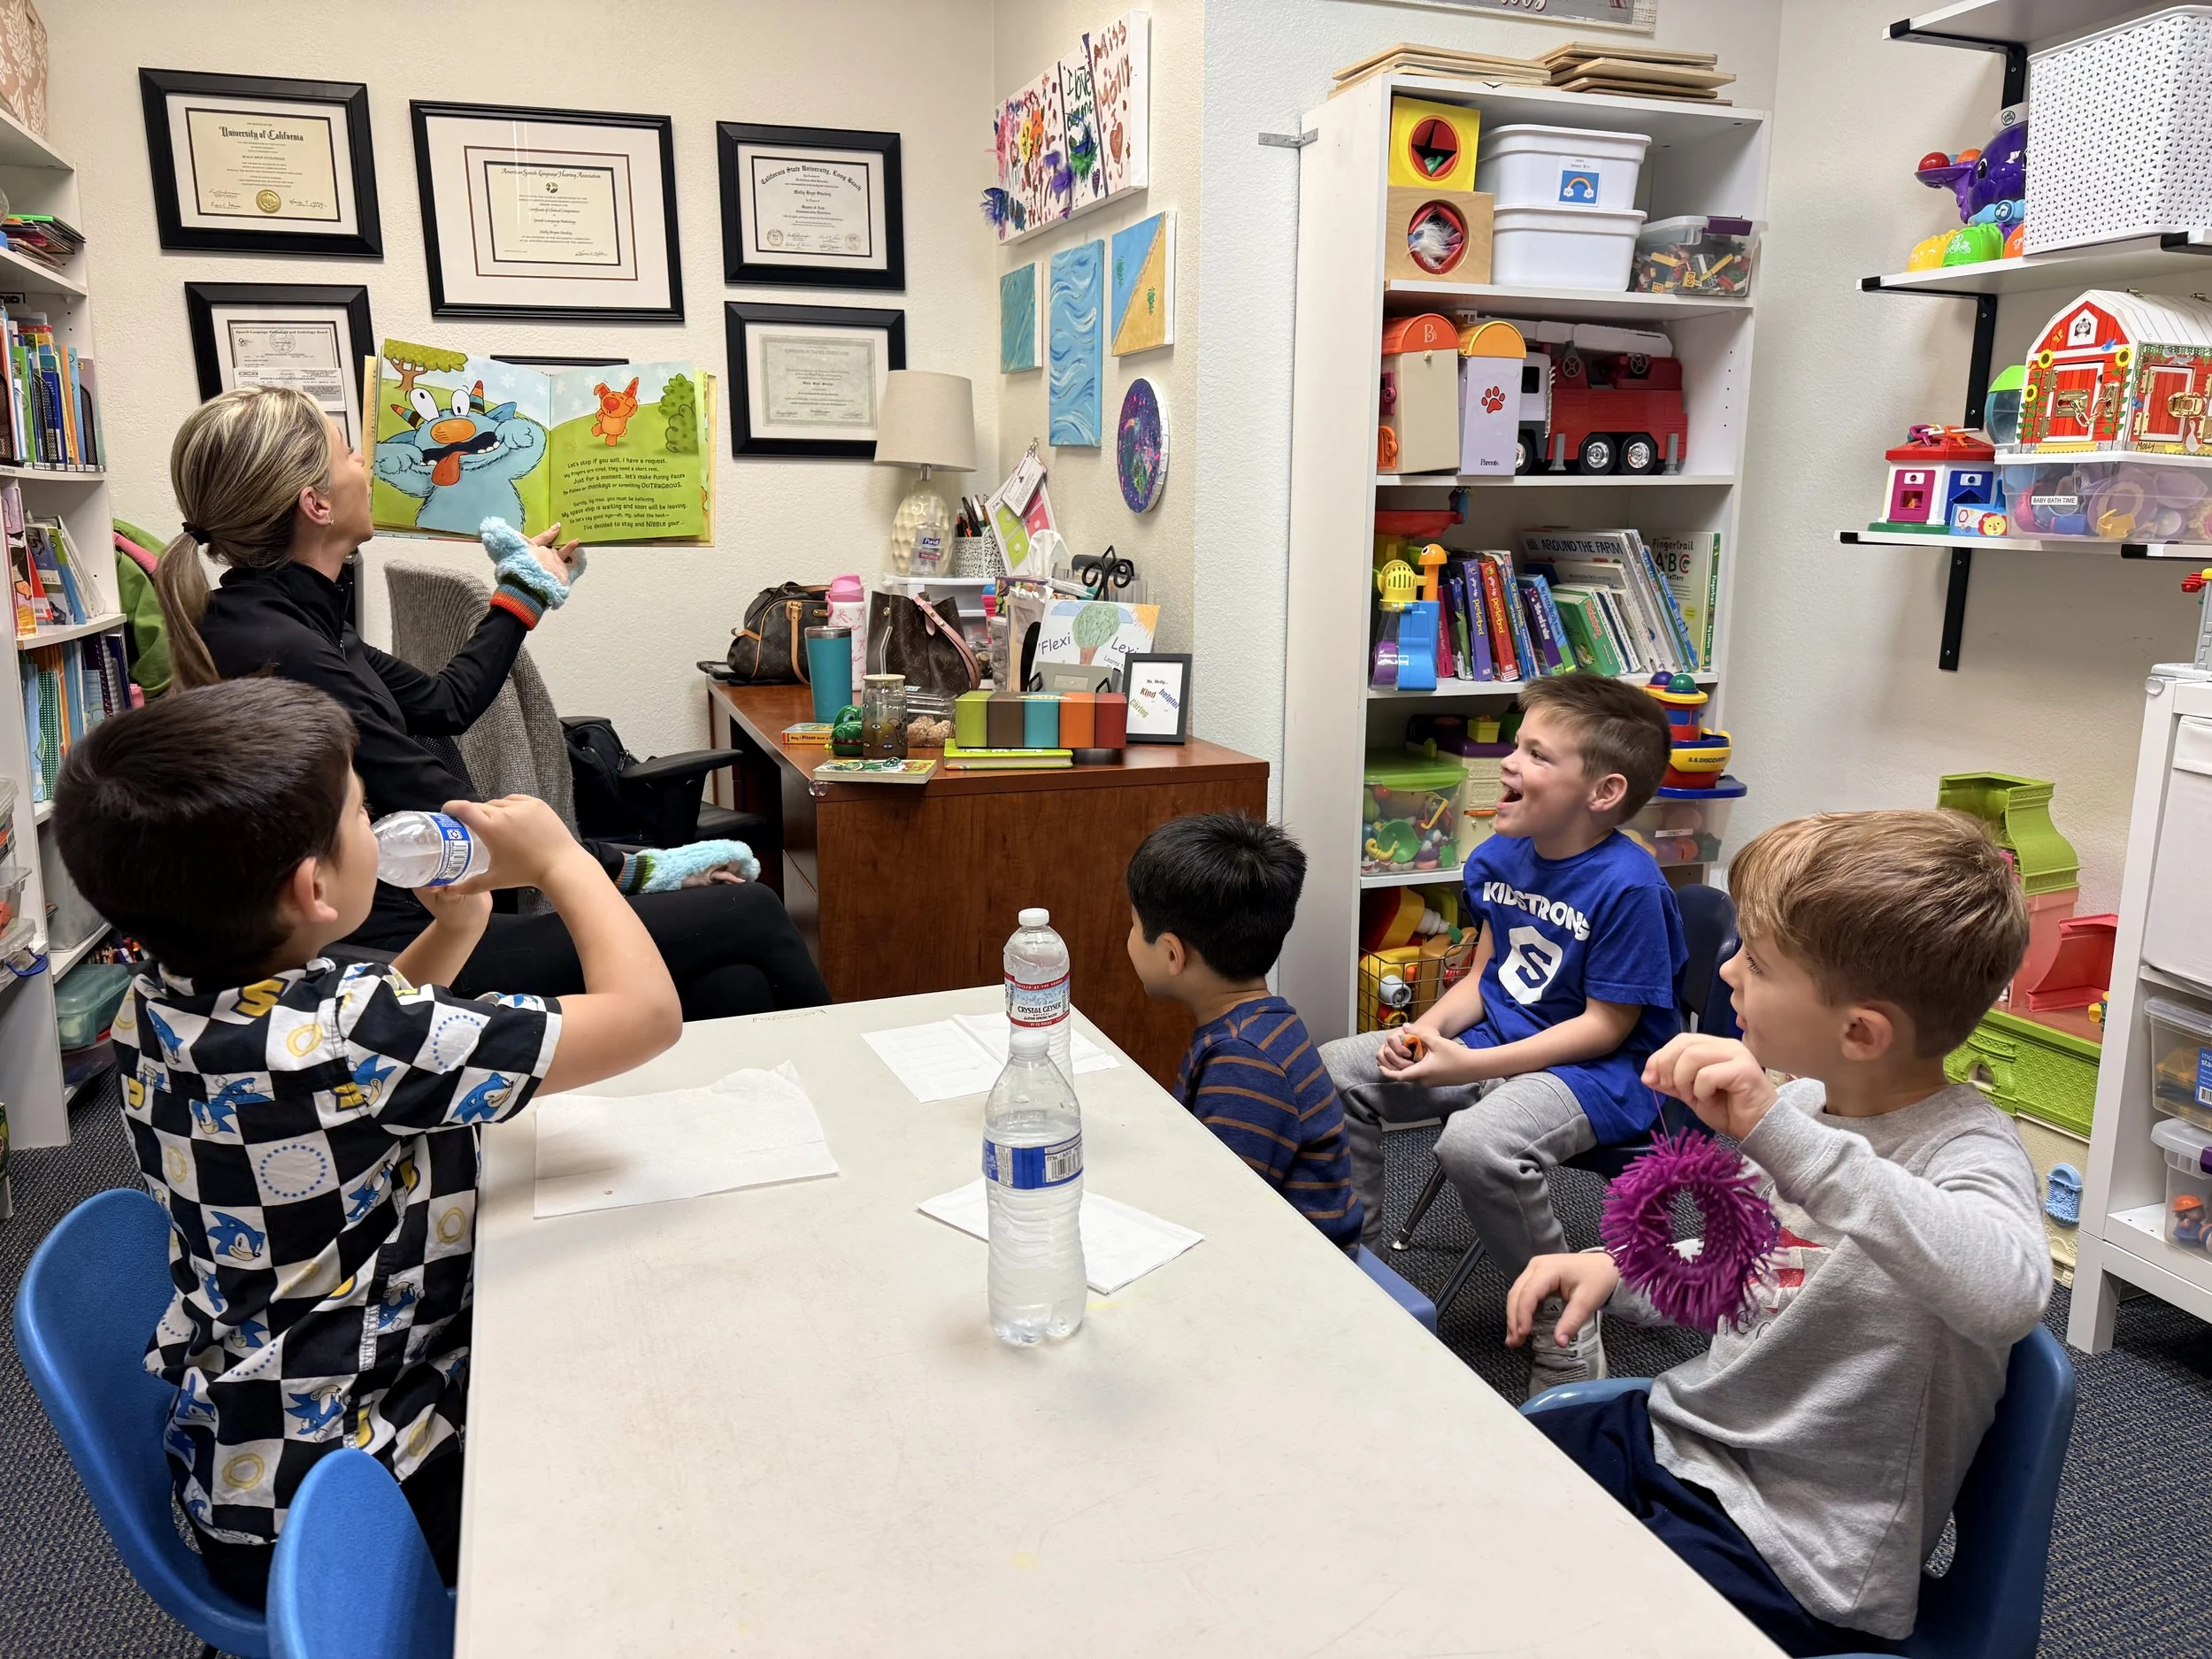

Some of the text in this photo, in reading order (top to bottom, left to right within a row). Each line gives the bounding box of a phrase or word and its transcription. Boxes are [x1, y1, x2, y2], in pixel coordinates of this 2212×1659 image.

[218, 126, 304, 141] University of California
[576, 171, 601, 179] Association
[760, 169, 786, 184] California
[801, 165, 831, 175] University,
[832, 170, 847, 181] Long
[848, 177, 862, 191] Beach
[2135, 442, 2155, 452] MOLLY
[1541, 538, 1623, 555] AROUND THE FARM
[1653, 538, 1694, 551] Fingertrail
[1140, 687, 1157, 699] Kind
[1130, 699, 1149, 718] Caring
[1482, 882, 1591, 941] KIDSTRONG
[1515, 943, 1552, 989] S
[1018, 1002, 1061, 1014] CRYSTAL GEYSER
